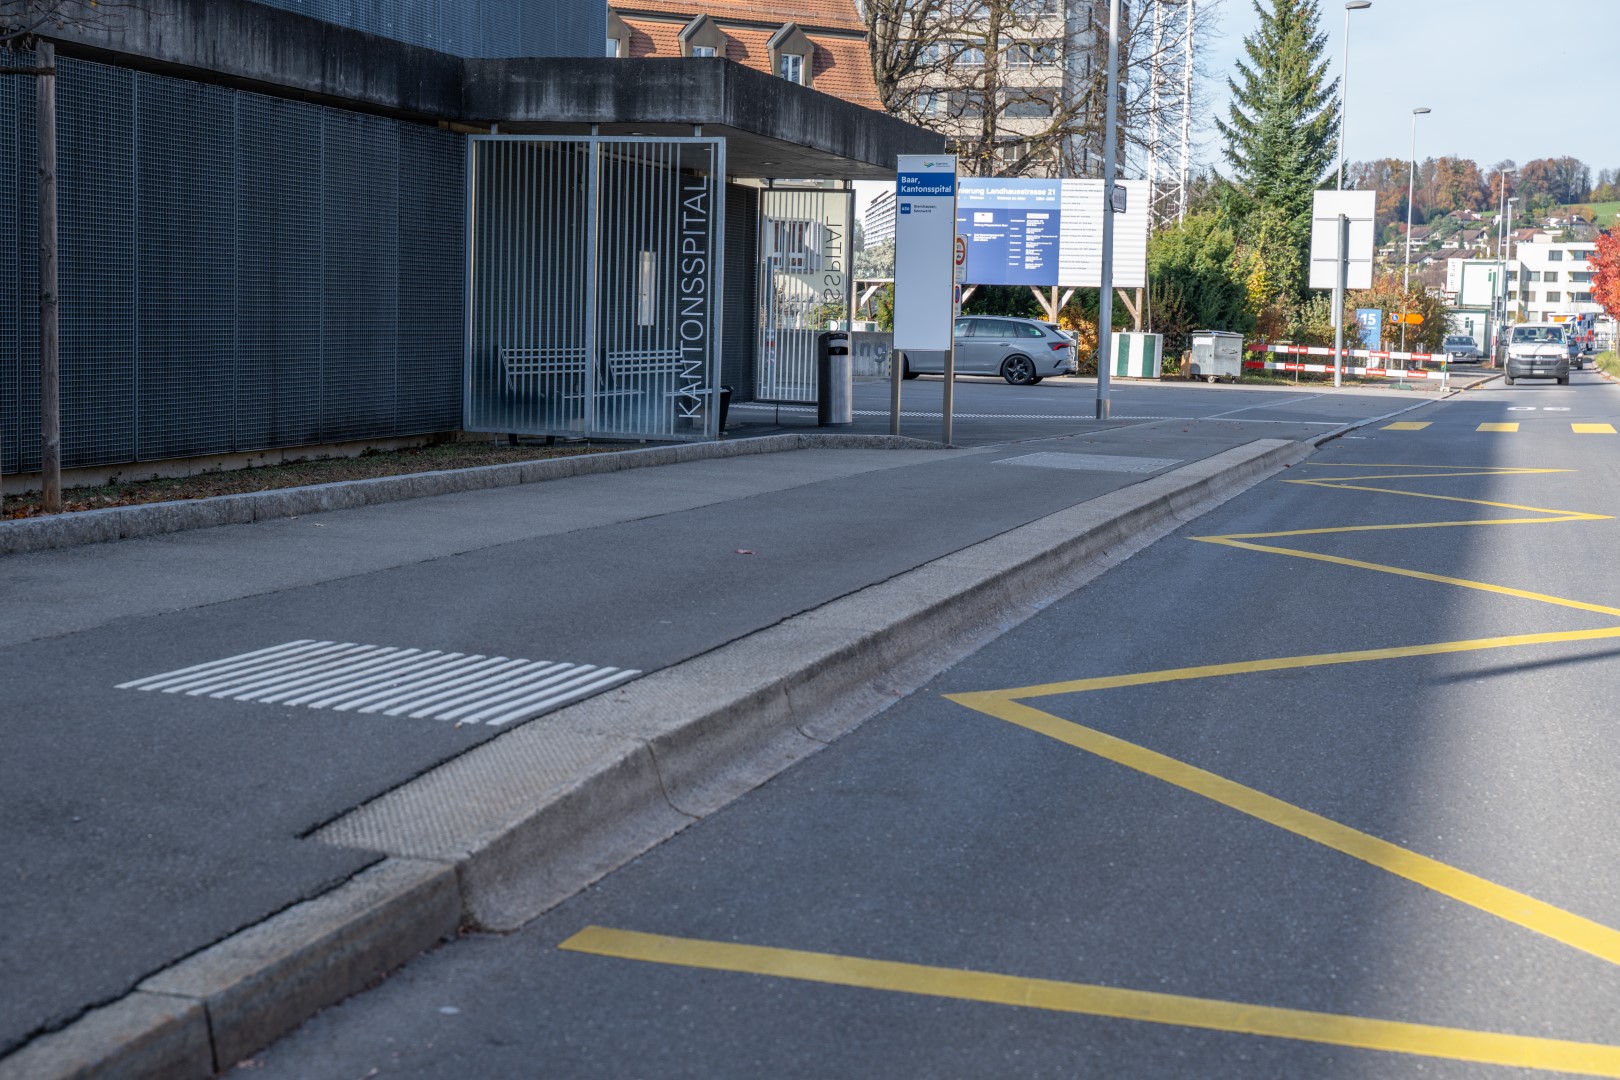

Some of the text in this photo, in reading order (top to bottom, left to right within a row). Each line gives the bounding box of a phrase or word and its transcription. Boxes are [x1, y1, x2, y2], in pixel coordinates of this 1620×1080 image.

[901, 176, 921, 185] Baar,
[901, 185, 952, 195] Kantonsspital
[957, 187, 1056, 196] nierung Landhausstrasse 21
[678, 175, 708, 418] KANTONSSPITAL
[1360, 313, 1377, 326] 15
